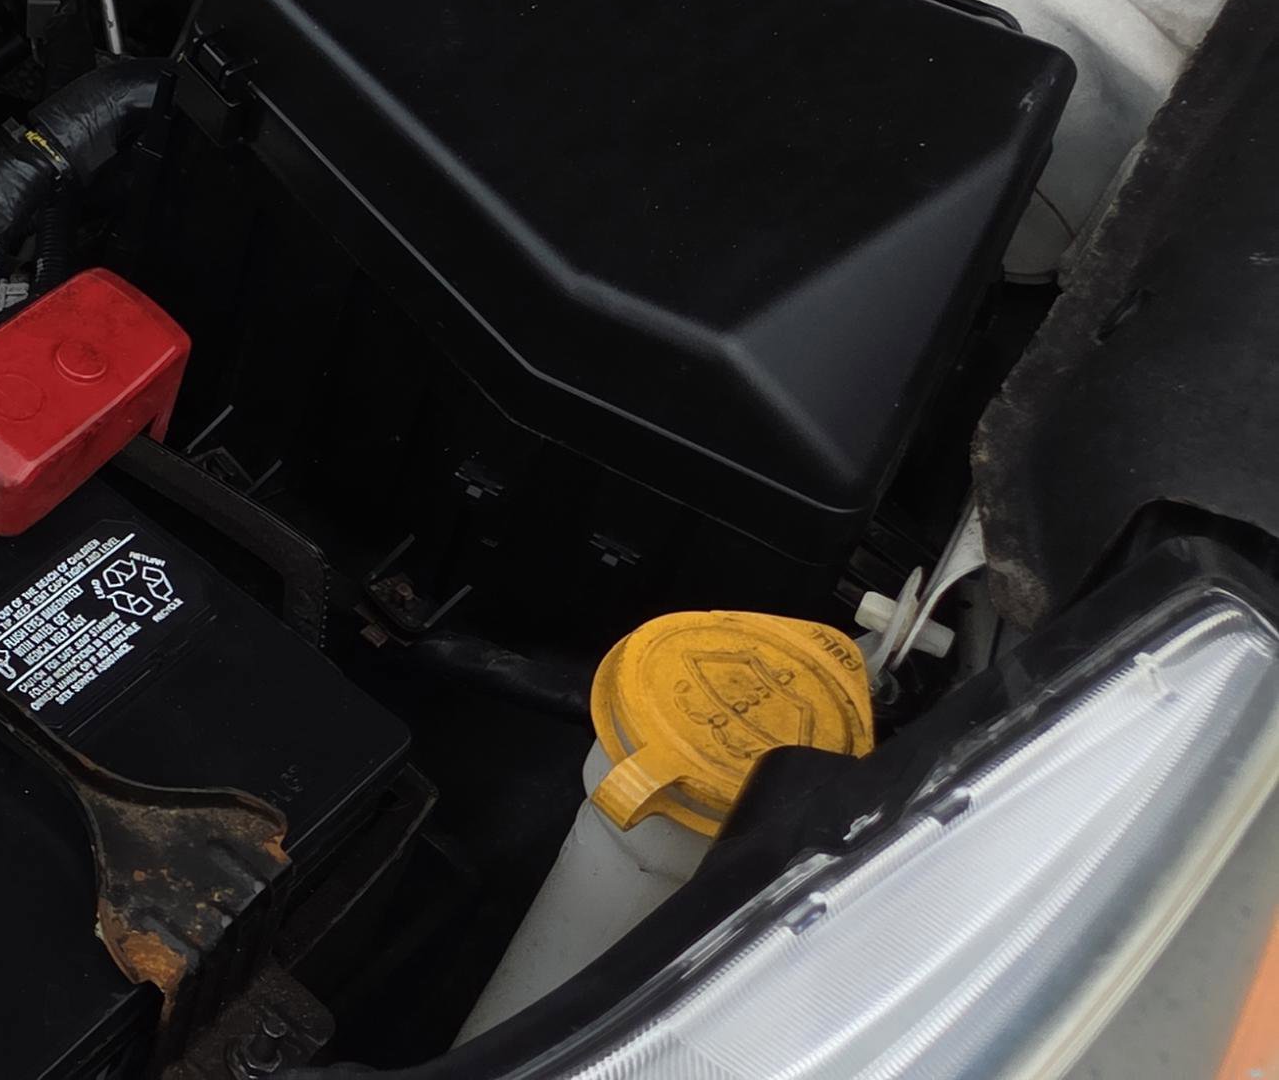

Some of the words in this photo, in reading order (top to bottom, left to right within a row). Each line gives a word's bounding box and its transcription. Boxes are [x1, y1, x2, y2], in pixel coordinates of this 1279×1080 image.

[11, 597, 23, 608] OF
[21, 586, 39, 600] THE
[35, 570, 61, 590] REACH
[57, 562, 69, 573] OF
[67, 539, 101, 565] CHILDREN
[13, 604, 31, 621] KEEP
[30, 590, 50, 606] VENT
[47, 576, 68, 593] CAPS
[64, 561, 86, 579] TIGHT
[85, 551, 101, 565] AND
[98, 537, 121, 554] LEVEL
[129, 551, 166, 567] RETURN
[3, 628, 29, 649] FLUSH
[23, 615, 45, 633] EYES
[40, 584, 84, 621] IMMEDIATELY
[12, 640, 35, 658] WITH
[53, 610, 71, 626] GET
[152, 597, 184, 623] RECYCLE
[23, 641, 56, 666] MEDICAL
[49, 627, 70, 645] HELP
[67, 614, 87, 632] FAST
[28, 676, 55, 699] FOLLOW
[53, 644, 97, 679] INSTRUCTIONS
[99, 620, 127, 642] VEHICLE
[45, 658, 61, 672] FOR
[57, 646, 77, 662] SAFE
[74, 634, 91, 650] JUMP
[88, 611, 120, 637] STARTING
[56, 669, 84, 690] MANUAL
[96, 645, 112, 660] NOT
[109, 622, 141, 649] AVAILABLE
[810, 627, 863, 673] PULL
[55, 689, 75, 705] SEEK
[70, 669, 99, 692] SERVICE
